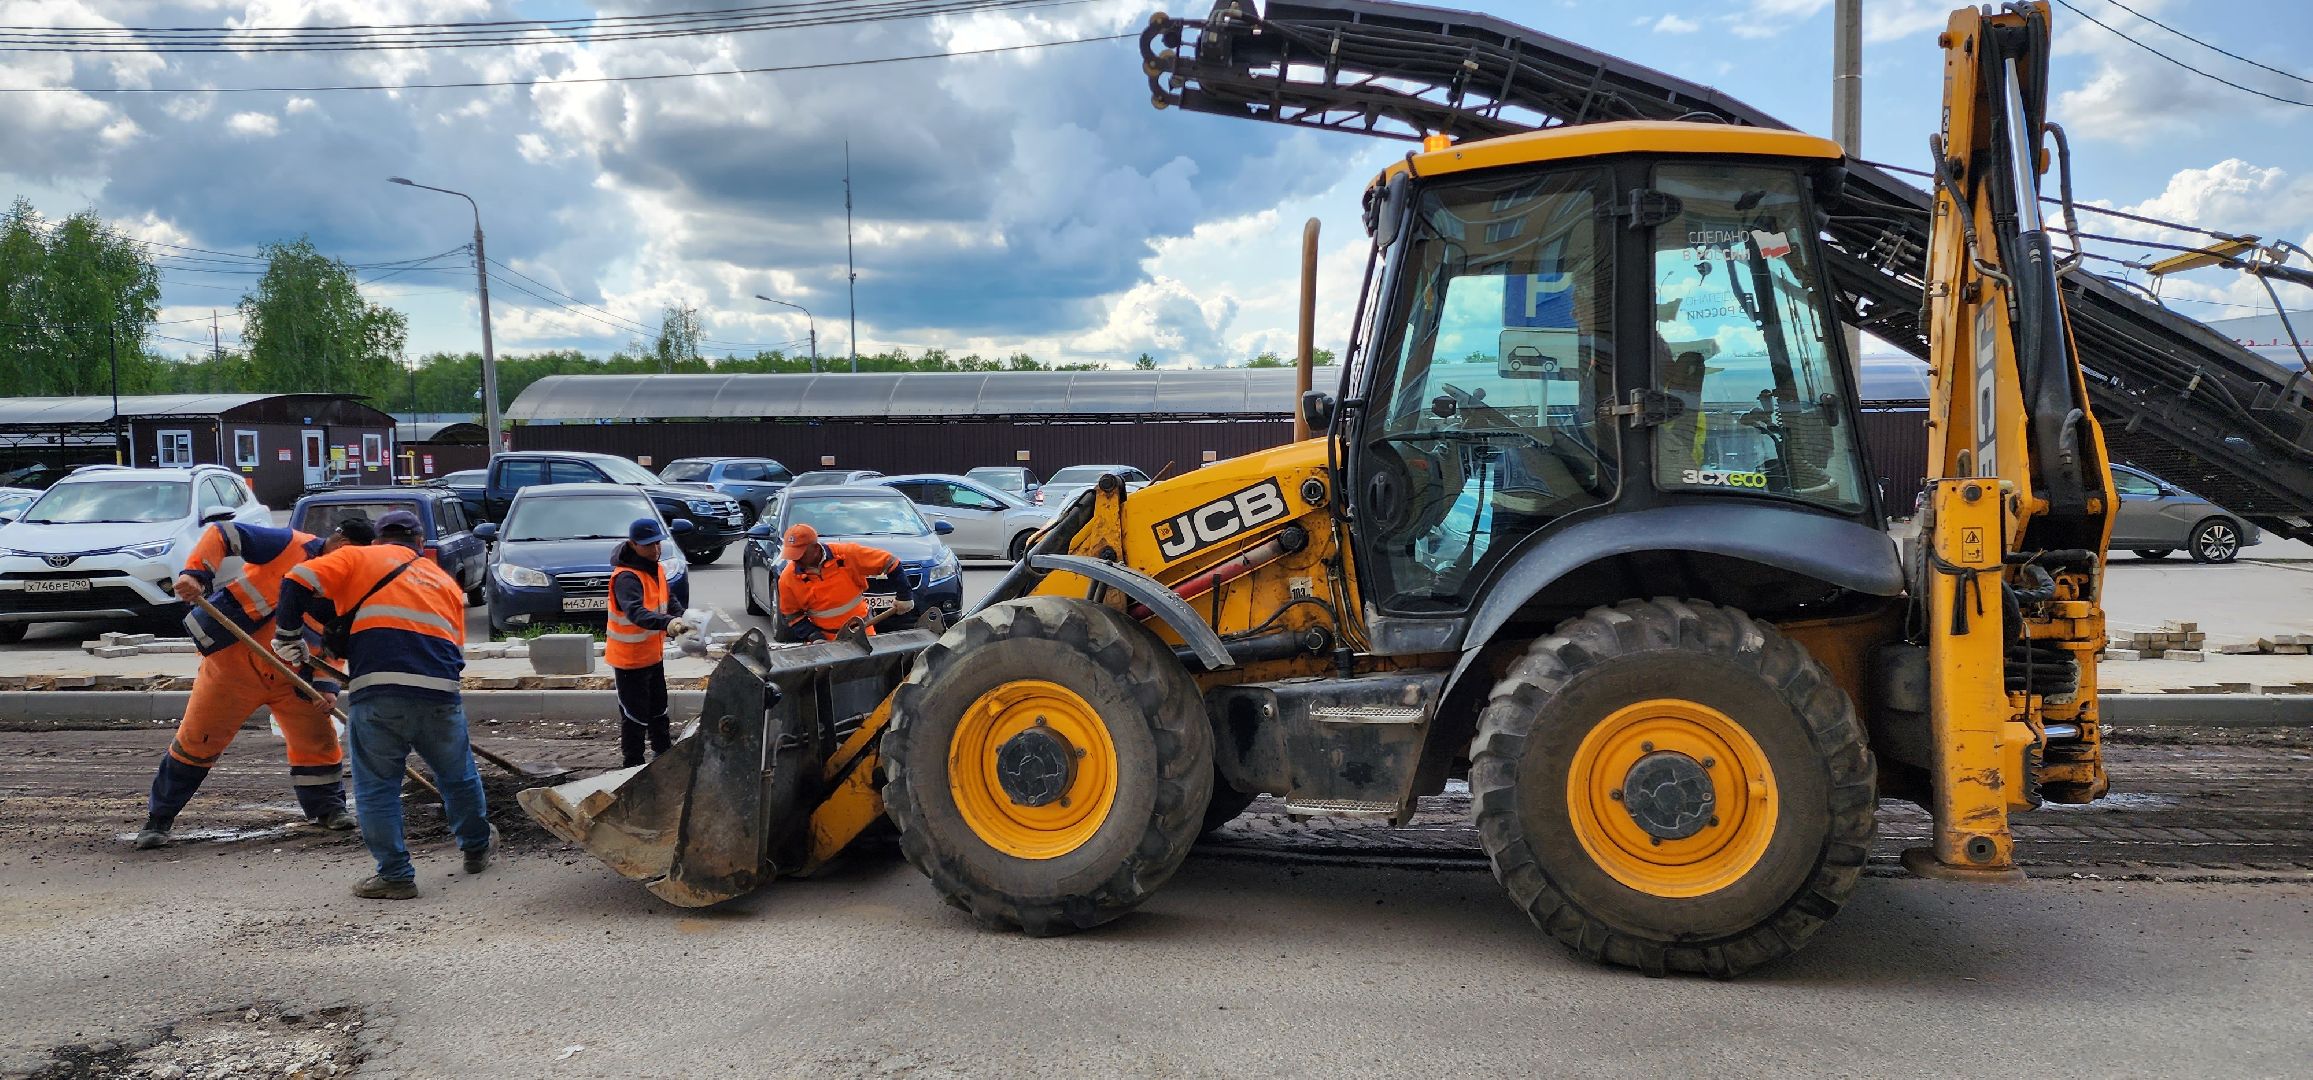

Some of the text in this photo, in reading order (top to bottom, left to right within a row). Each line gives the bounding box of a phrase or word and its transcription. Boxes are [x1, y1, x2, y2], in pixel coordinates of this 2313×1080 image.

[1688, 230, 1750, 244] СДЕЛАНО
[1683, 250, 1690, 260] В
[1525, 272, 1574, 317] P
[1682, 469, 1767, 488] 3CXeco
[1161, 483, 1284, 557] JCB
